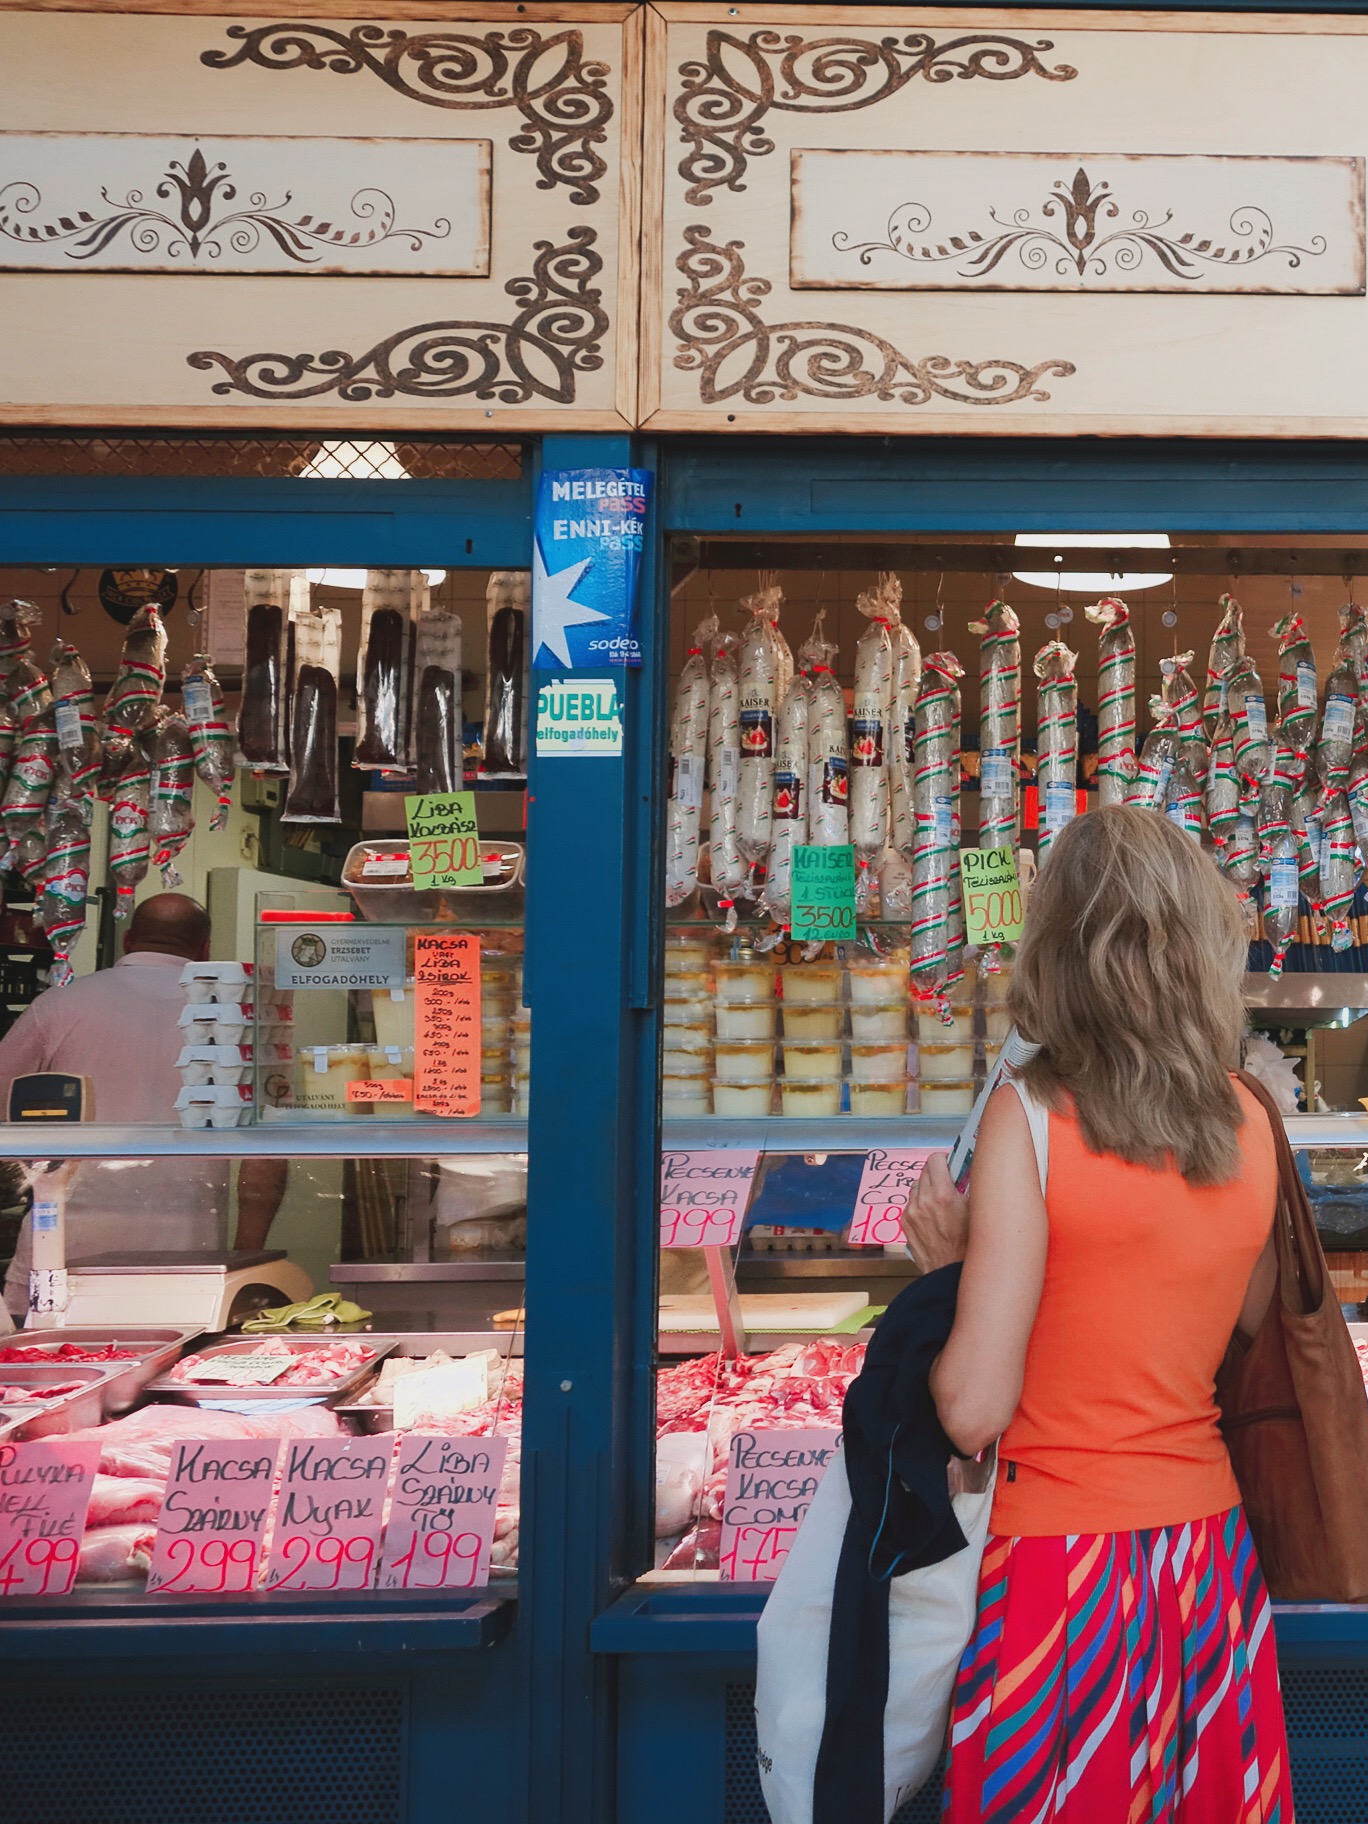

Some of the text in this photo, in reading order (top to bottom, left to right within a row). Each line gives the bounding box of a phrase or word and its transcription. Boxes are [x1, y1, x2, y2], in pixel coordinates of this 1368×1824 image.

[552, 478, 645, 501] MELEGÉTEL
[553, 517, 644, 540] ENNI-KÉK
[537, 727, 619, 743] elfogadóhely
[115, 816, 138, 825] PICK
[794, 847, 854, 869] KAISER
[963, 849, 1011, 872] PICK
[331, 946, 371, 954] ERZSÉBET
[291, 973, 390, 984] ELFOGADÓHELY
[661, 1183, 738, 1205] KACSA
[854, 1205, 907, 1244] 18
[175, 1444, 272, 1483] KACSA
[288, 1445, 386, 1483] KACSA
[397, 1476, 496, 1506] SZÁRNY
[735, 1473, 818, 1500] KACSA
[160, 1490, 267, 1534] SZÁRNY
